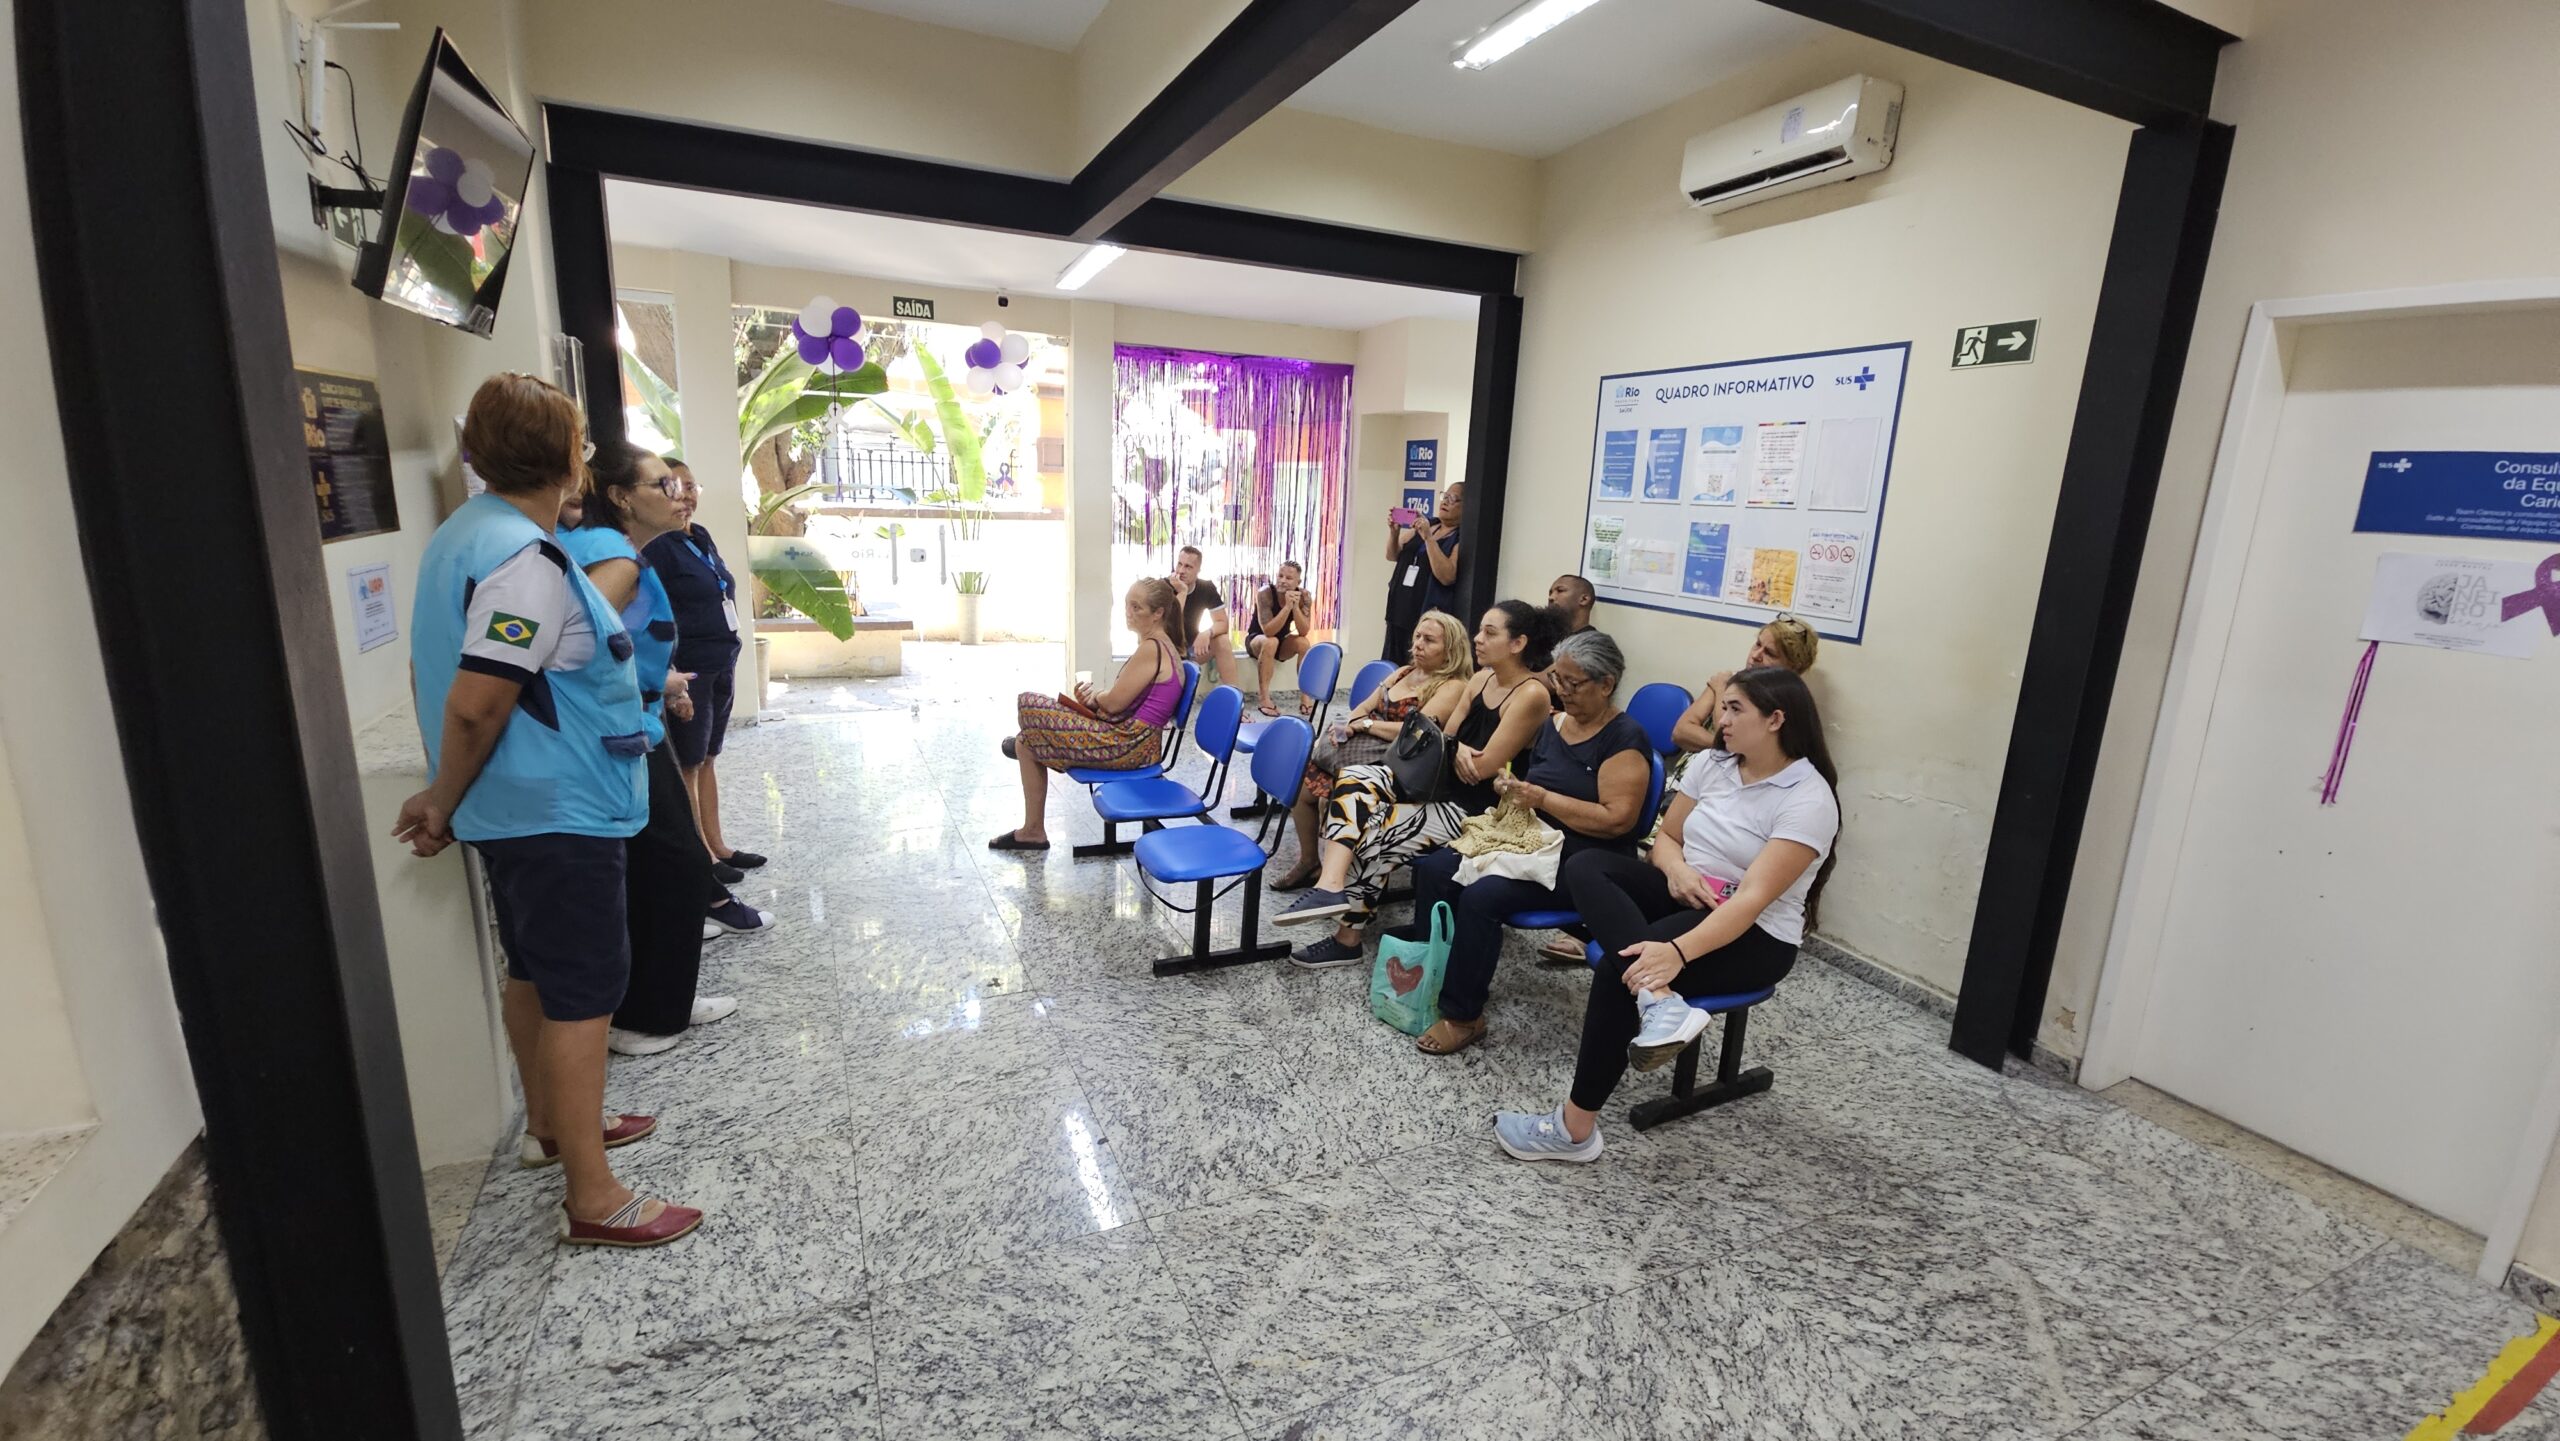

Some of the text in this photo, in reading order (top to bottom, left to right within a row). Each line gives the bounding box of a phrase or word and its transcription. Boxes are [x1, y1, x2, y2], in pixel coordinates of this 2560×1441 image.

[896, 300, 932, 318] SAÍDA
[1835, 376, 1852, 386] SUS
[1625, 386, 1640, 398] Rio
[1655, 374, 1815, 403] QUADRO INFORMATIVO
[1418, 447, 1433, 460] Rio
[2503, 477, 2527, 490] da
